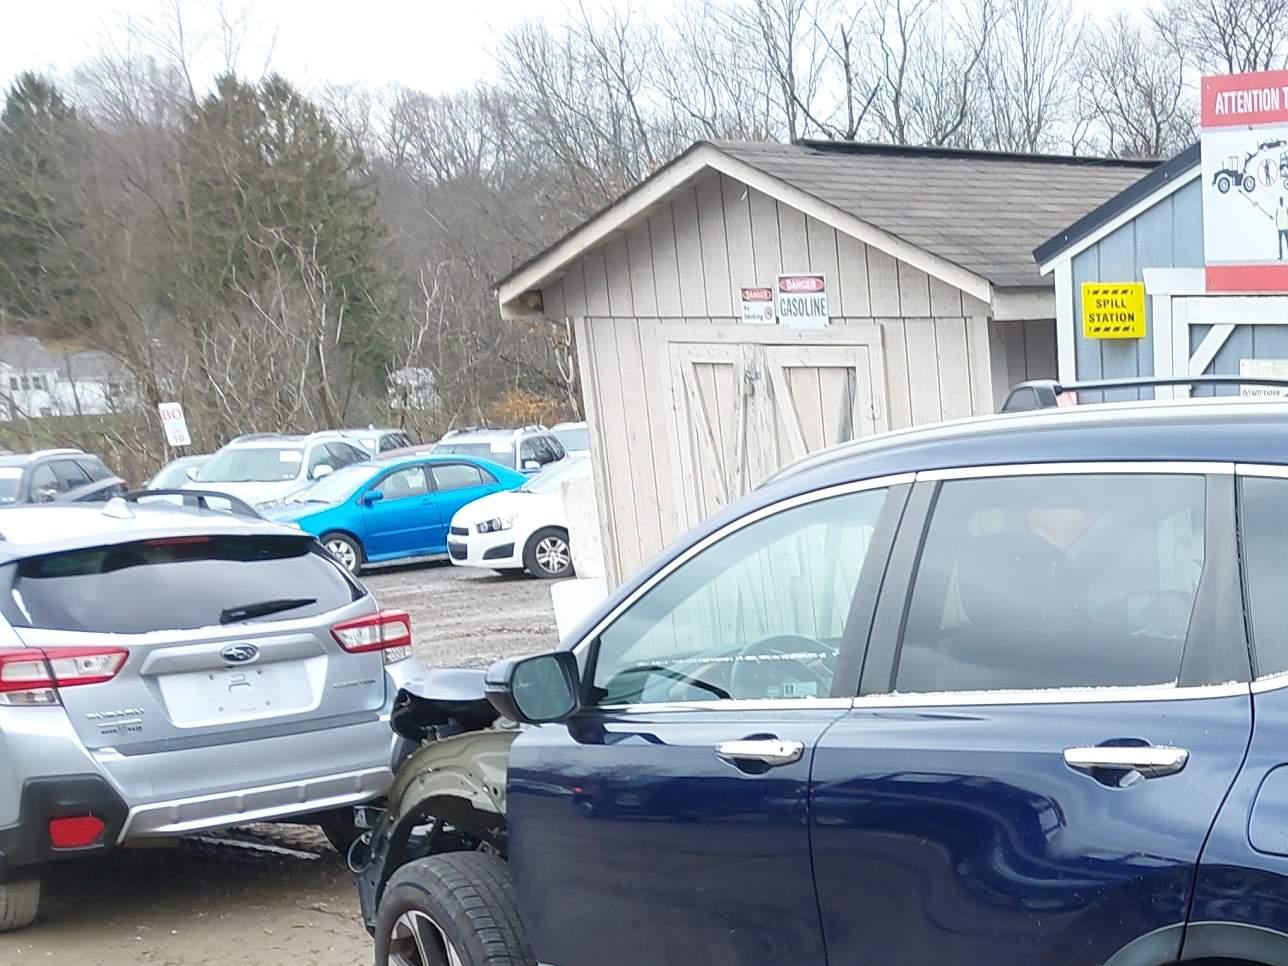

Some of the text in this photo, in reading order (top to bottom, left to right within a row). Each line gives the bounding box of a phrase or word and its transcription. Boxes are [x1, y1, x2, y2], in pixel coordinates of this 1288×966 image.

[1215, 87, 1280, 115] ATTENTION
[785, 279, 816, 291] DANGER
[745, 290, 769, 299] DANGER
[780, 297, 827, 318] GASOLINE
[1096, 298, 1127, 309] SPILL
[1089, 312, 1135, 323] STATION
